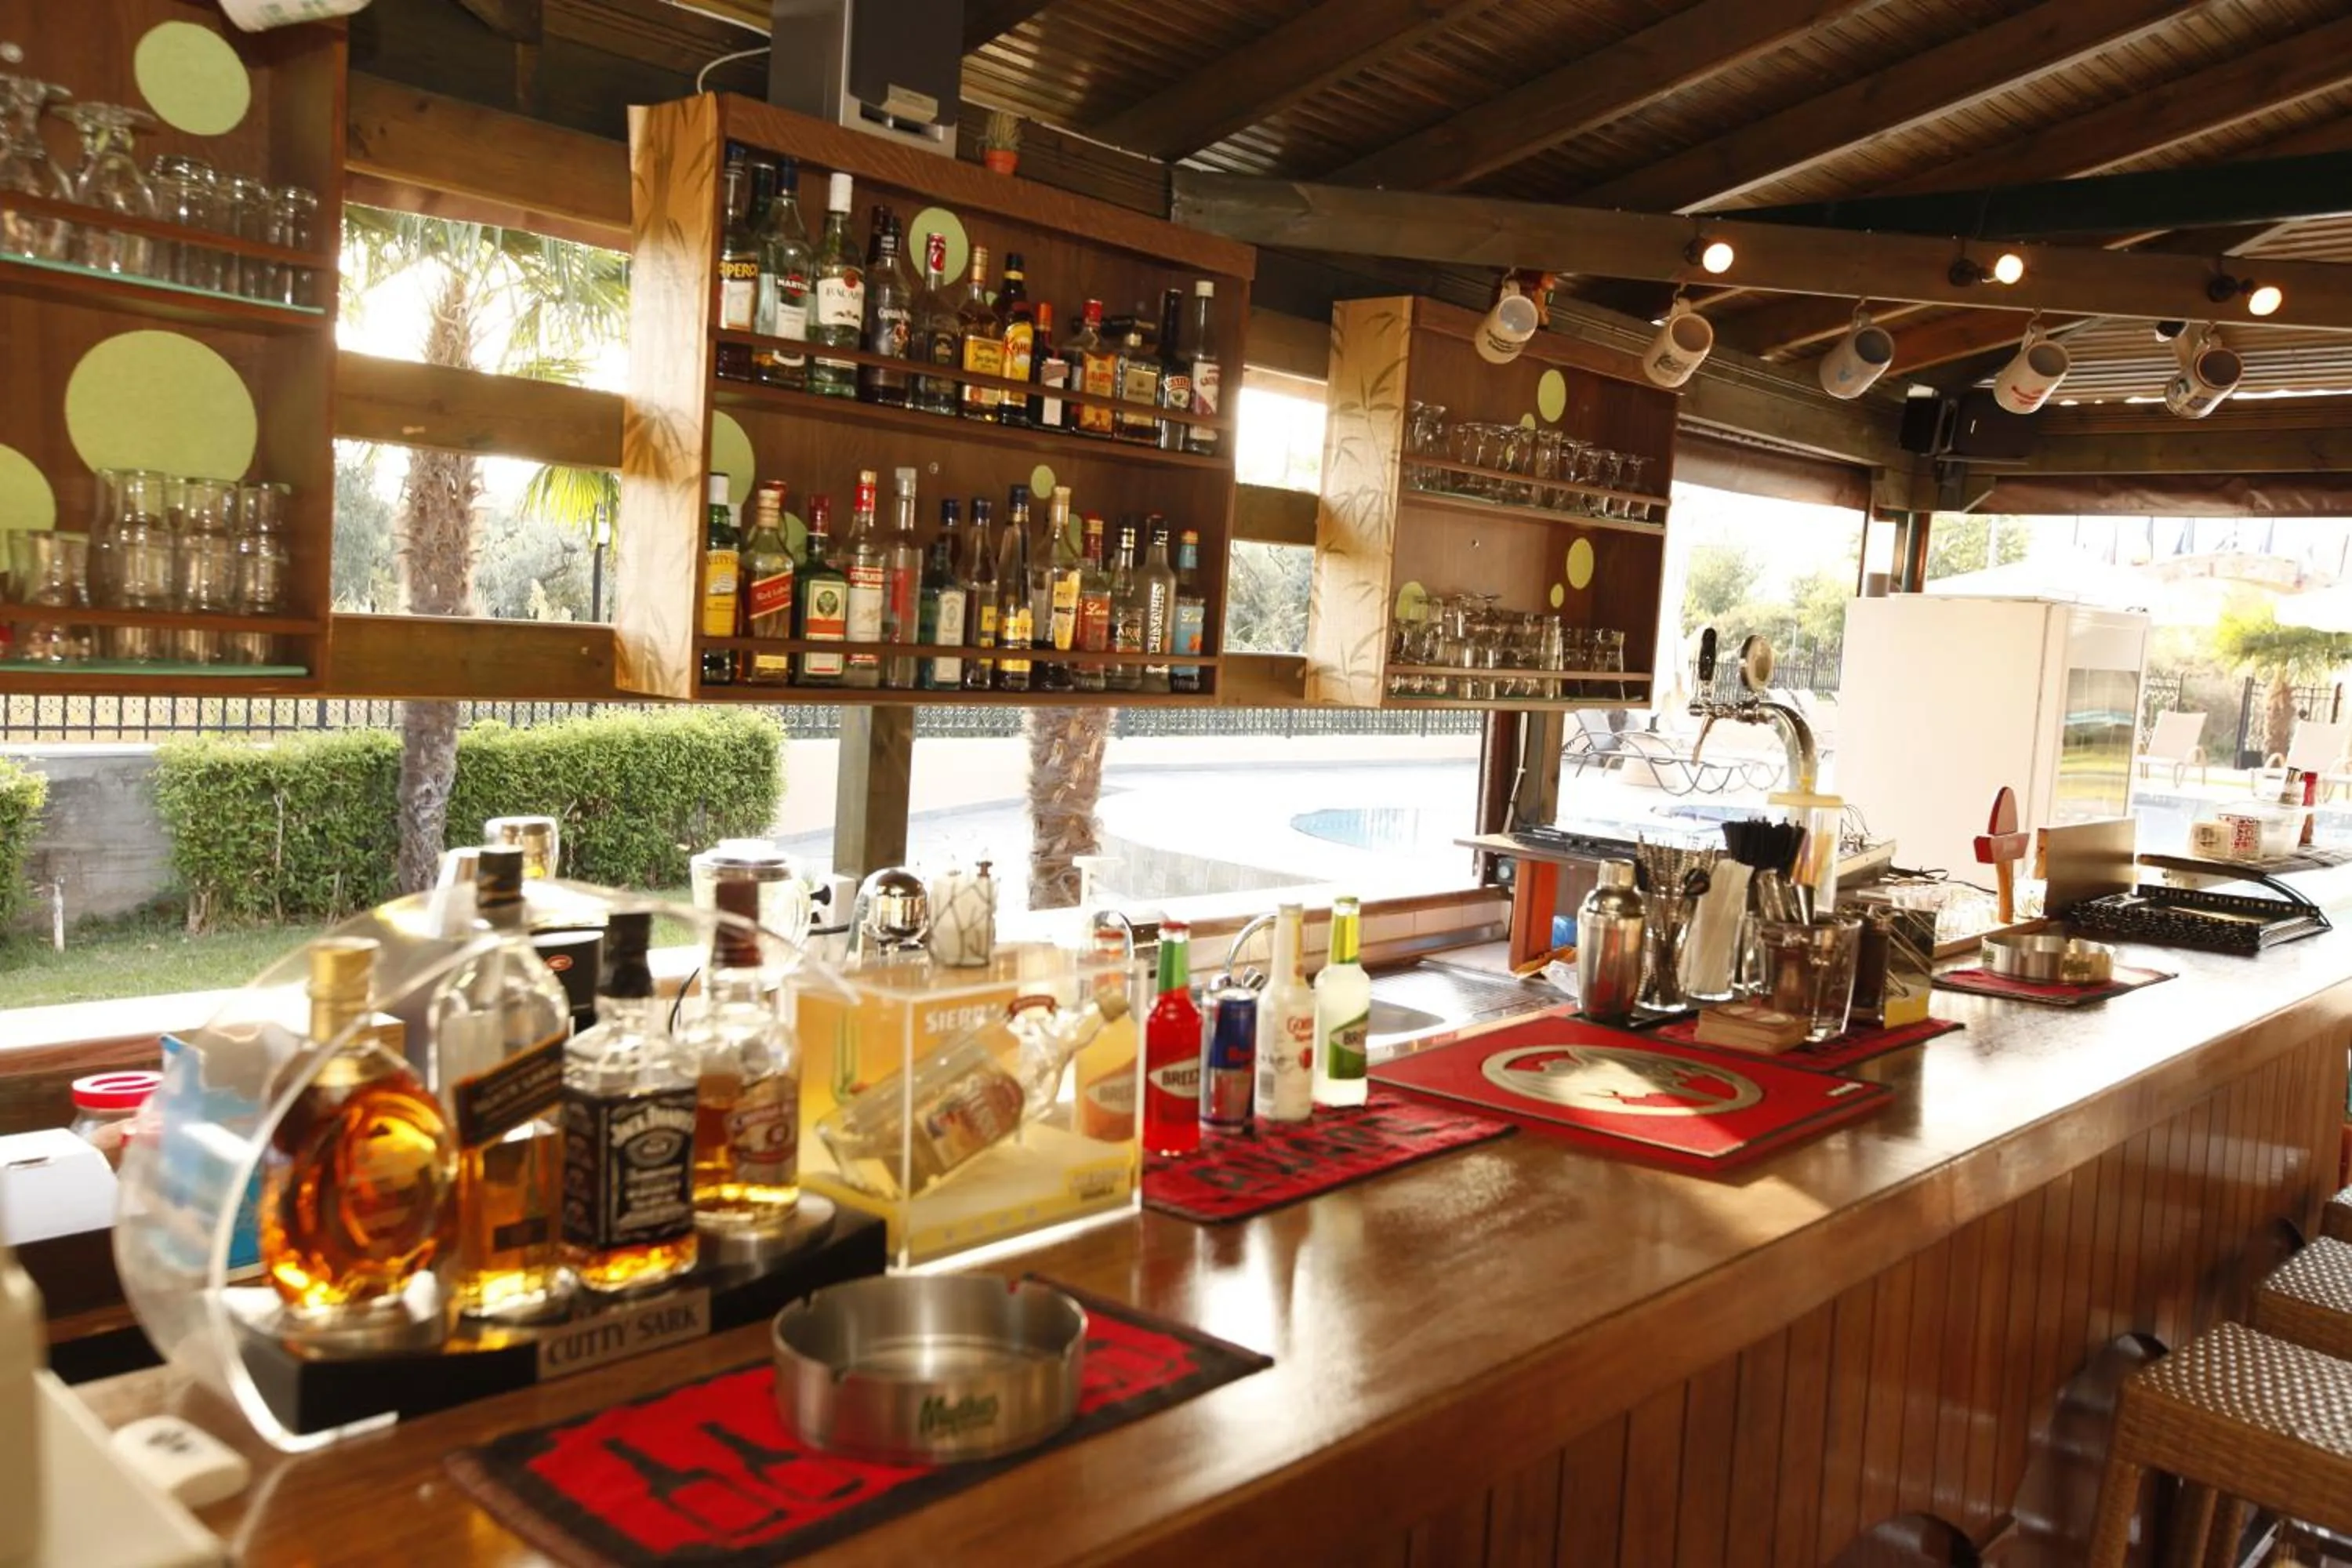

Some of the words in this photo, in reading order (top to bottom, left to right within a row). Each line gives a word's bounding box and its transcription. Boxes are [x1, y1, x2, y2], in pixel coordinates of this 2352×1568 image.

[777, 278, 811, 292] MARTINI
[548, 1318, 632, 1365] CUTTY
[637, 1305, 699, 1336] SARK
